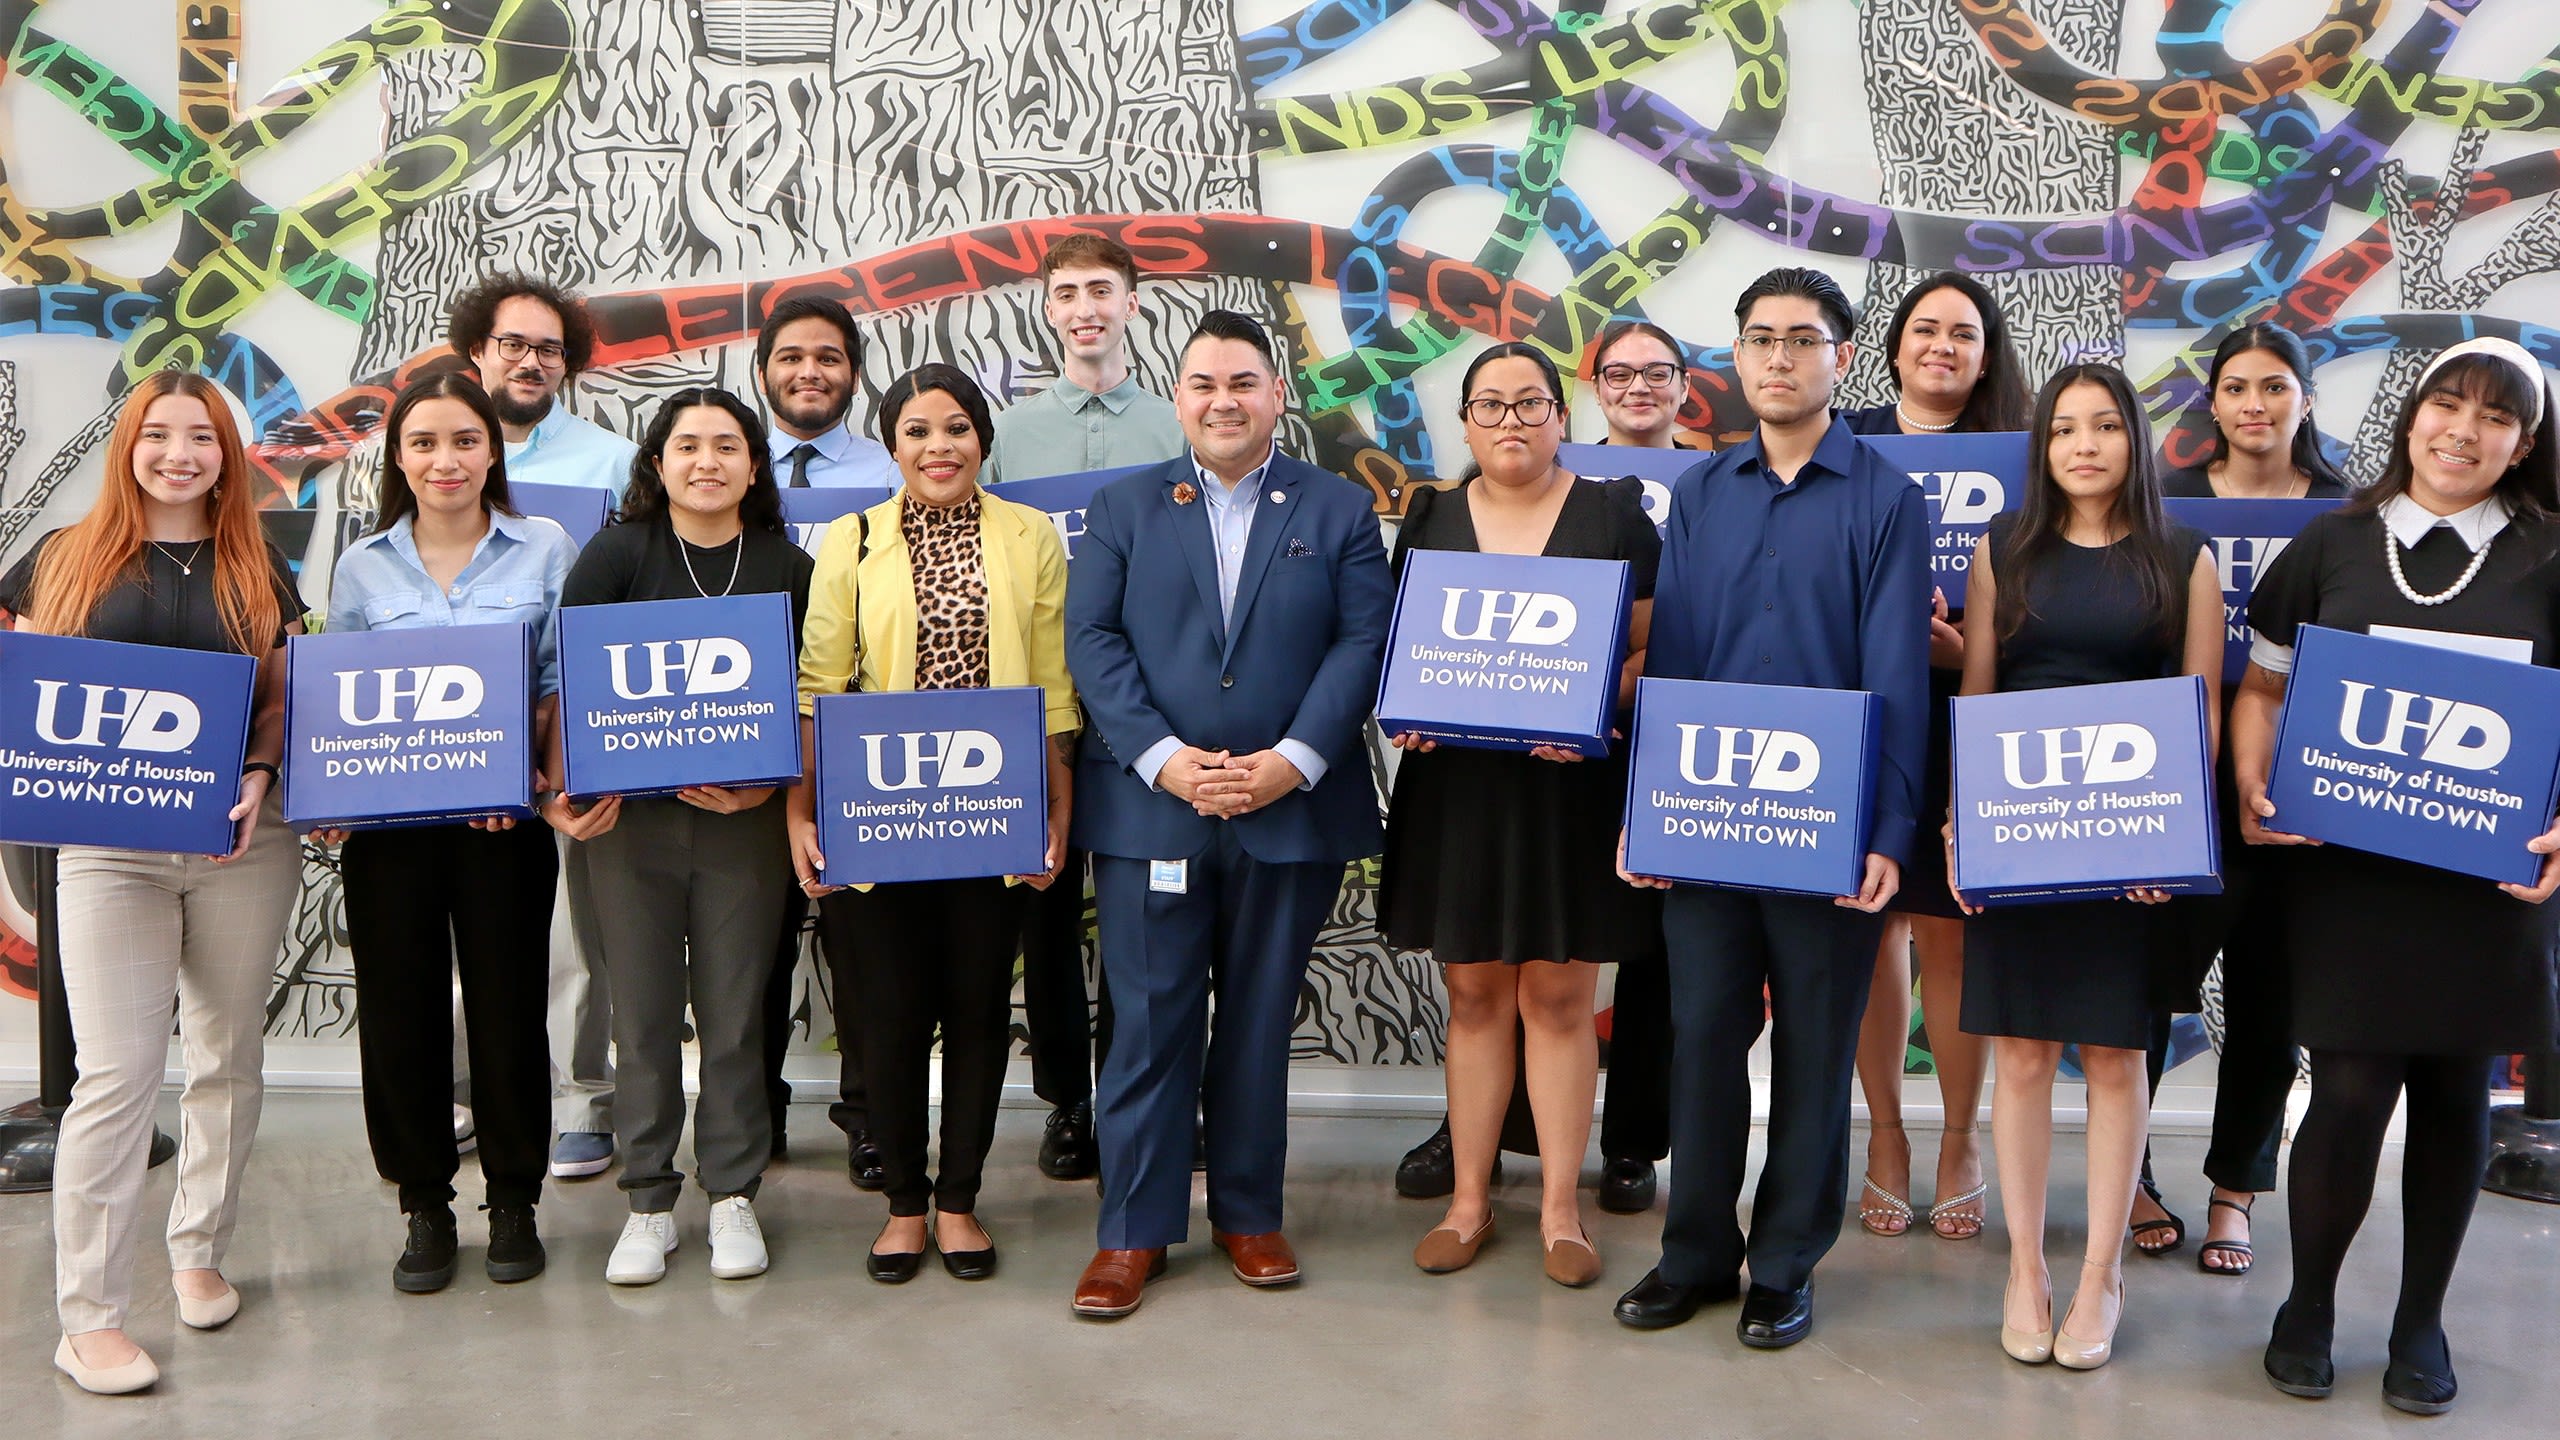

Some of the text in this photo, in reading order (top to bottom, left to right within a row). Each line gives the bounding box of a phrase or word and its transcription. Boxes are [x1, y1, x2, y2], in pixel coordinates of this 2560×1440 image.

[1935, 531, 1952, 547] of
[1442, 588, 1577, 646] UHD
[604, 637, 752, 699] UHD
[1412, 644, 1588, 673] University of Houston
[334, 665, 484, 727] UHD
[1420, 668, 1569, 696] DOWNTOWN
[34, 679, 200, 752] UHD
[588, 701, 774, 728] University of Houston
[2340, 680, 2511, 774] UHD
[312, 728, 504, 754] University of Houston
[605, 722, 760, 751] DOWNTOWN
[0, 749, 215, 783] University of Houston
[327, 750, 486, 777] DOWNTOWN
[860, 730, 1002, 791] UHD
[1677, 724, 1821, 791] UHD
[1996, 723, 2157, 790] UHD
[12, 777, 194, 810] DOWNTOWN
[2303, 747, 2523, 810] University of Houston
[843, 794, 1023, 819] University of Houston
[1652, 790, 1836, 823] University of Houston
[1978, 791, 2182, 818] University of Houston
[2314, 776, 2498, 835] DOWNTOWN
[859, 817, 1008, 843] DOWNTOWN
[1664, 817, 1818, 850] DOWNTOWN
[1995, 815, 2165, 843] DOWNTOWN
